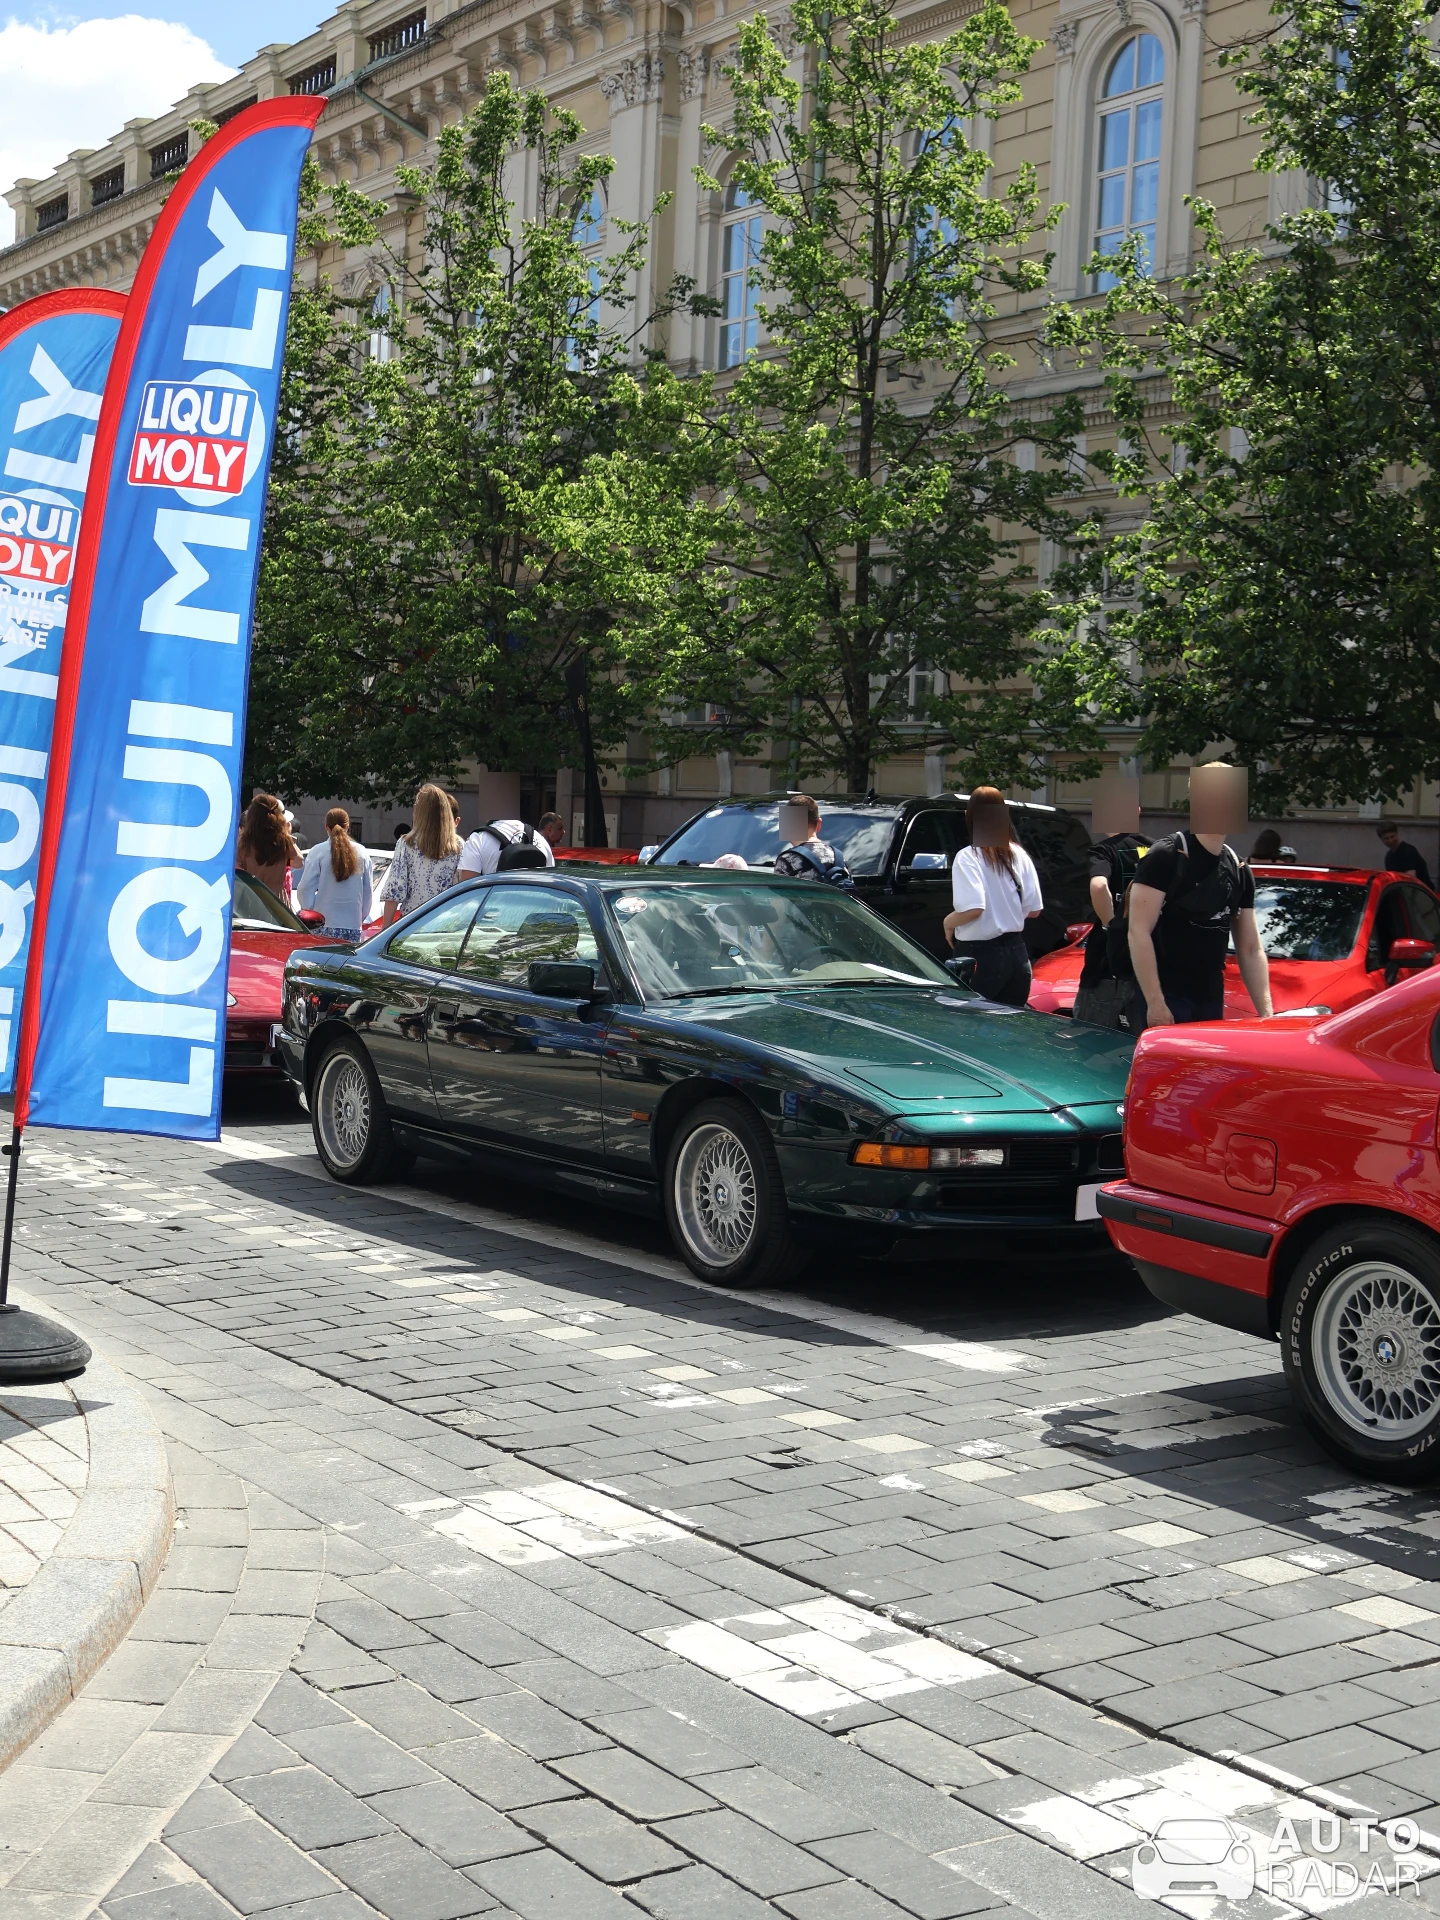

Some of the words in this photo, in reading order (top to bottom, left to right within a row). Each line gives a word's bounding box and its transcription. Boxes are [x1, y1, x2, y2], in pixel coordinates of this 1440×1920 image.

[142, 387, 249, 437] LIQUI
[134, 437, 245, 488] MOLY
[17, 587, 67, 612] OILS
[103, 699, 234, 1118] LIQUI
[1291, 1245, 1353, 1367] BFGoodrich
[1406, 1434, 1437, 1457] T/A
